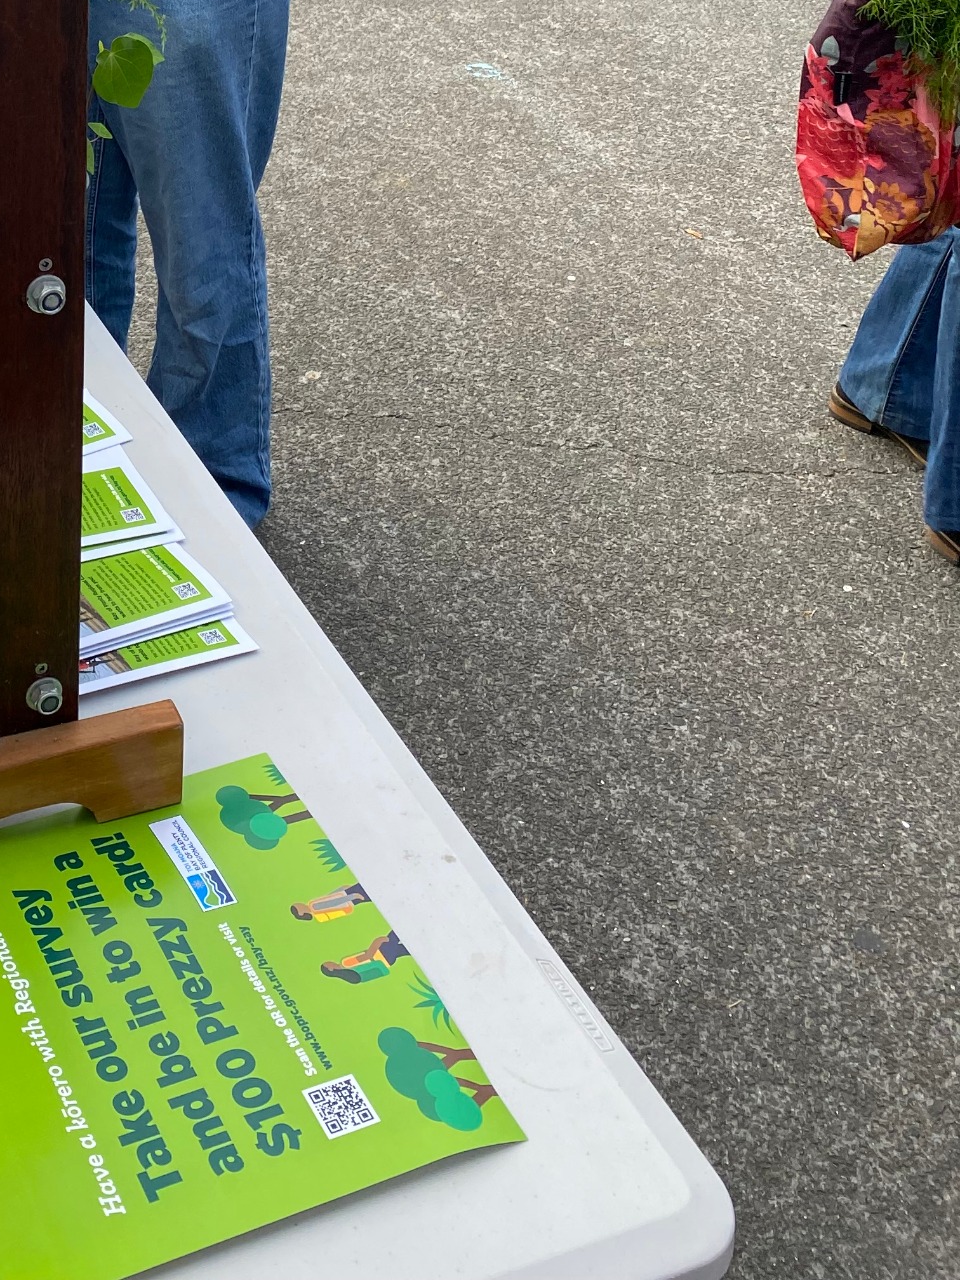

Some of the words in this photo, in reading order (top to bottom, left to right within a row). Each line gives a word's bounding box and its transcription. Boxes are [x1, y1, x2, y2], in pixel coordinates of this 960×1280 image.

[171, 832, 188, 852] PLENTY
[172, 819, 190, 842] COUNCIL
[53, 851, 84, 872] a
[90, 831, 163, 909] card!
[170, 842, 187, 863] MOANA
[183, 862, 194, 873] TOI
[184, 851, 193, 860] OF
[187, 841, 209, 870] REGIONAL
[190, 860, 201, 871] BAY
[66, 874, 119, 937] win
[11, 889, 94, 1008] survey
[217, 921, 238, 946] visit
[102, 939, 142, 984] to
[232, 946, 245, 958] or
[145, 917, 240, 1046] Prezzy
[240, 958, 267, 994] details
[124, 984, 167, 1031] in
[238, 926, 333, 1071] www.boprc.govt.nz/bay-say
[261, 994, 277, 1010] for
[270, 1009, 287, 1027] QR
[20, 1017, 56, 1063] with
[72, 1015, 129, 1083] our
[283, 1027, 300, 1048] the
[148, 1030, 198, 1089] be
[294, 1047, 318, 1077] Scan
[48, 1065, 89, 1133] kōrero
[215, 1048, 303, 1157] $100
[78, 1133, 97, 1149] a
[112, 1088, 184, 1204] Take
[167, 1087, 245, 1177] and
[89, 1154, 127, 1217] Have
